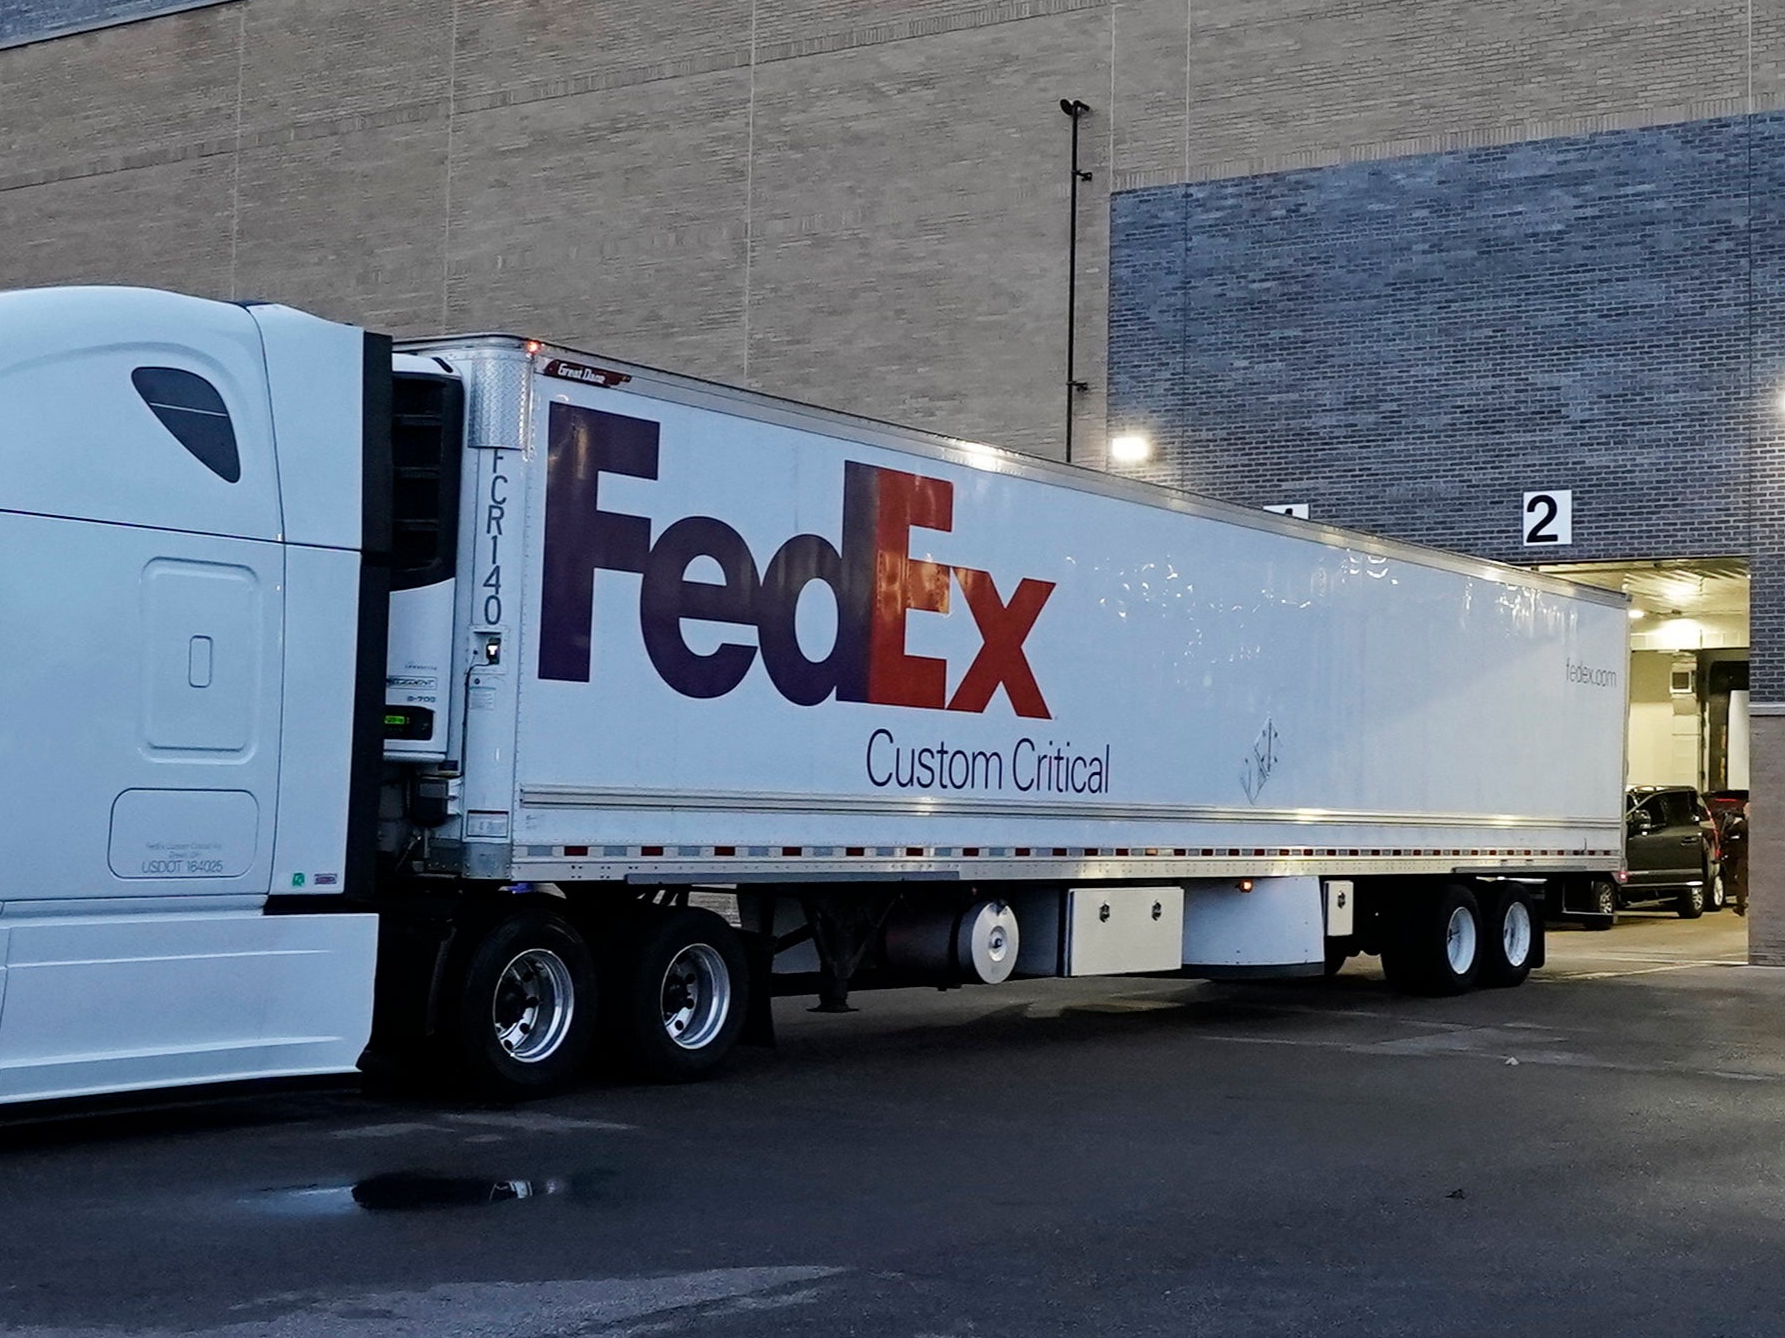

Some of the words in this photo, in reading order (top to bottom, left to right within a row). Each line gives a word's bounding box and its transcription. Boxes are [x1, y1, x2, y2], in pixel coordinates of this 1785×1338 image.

[1526, 494, 1559, 543] 2
[538, 401, 1057, 720] FedEx
[1566, 657, 1617, 687] fedex.com
[866, 728, 1003, 789] Custom
[1012, 737, 1110, 794] Critical
[141, 860, 183, 874] USDOT
